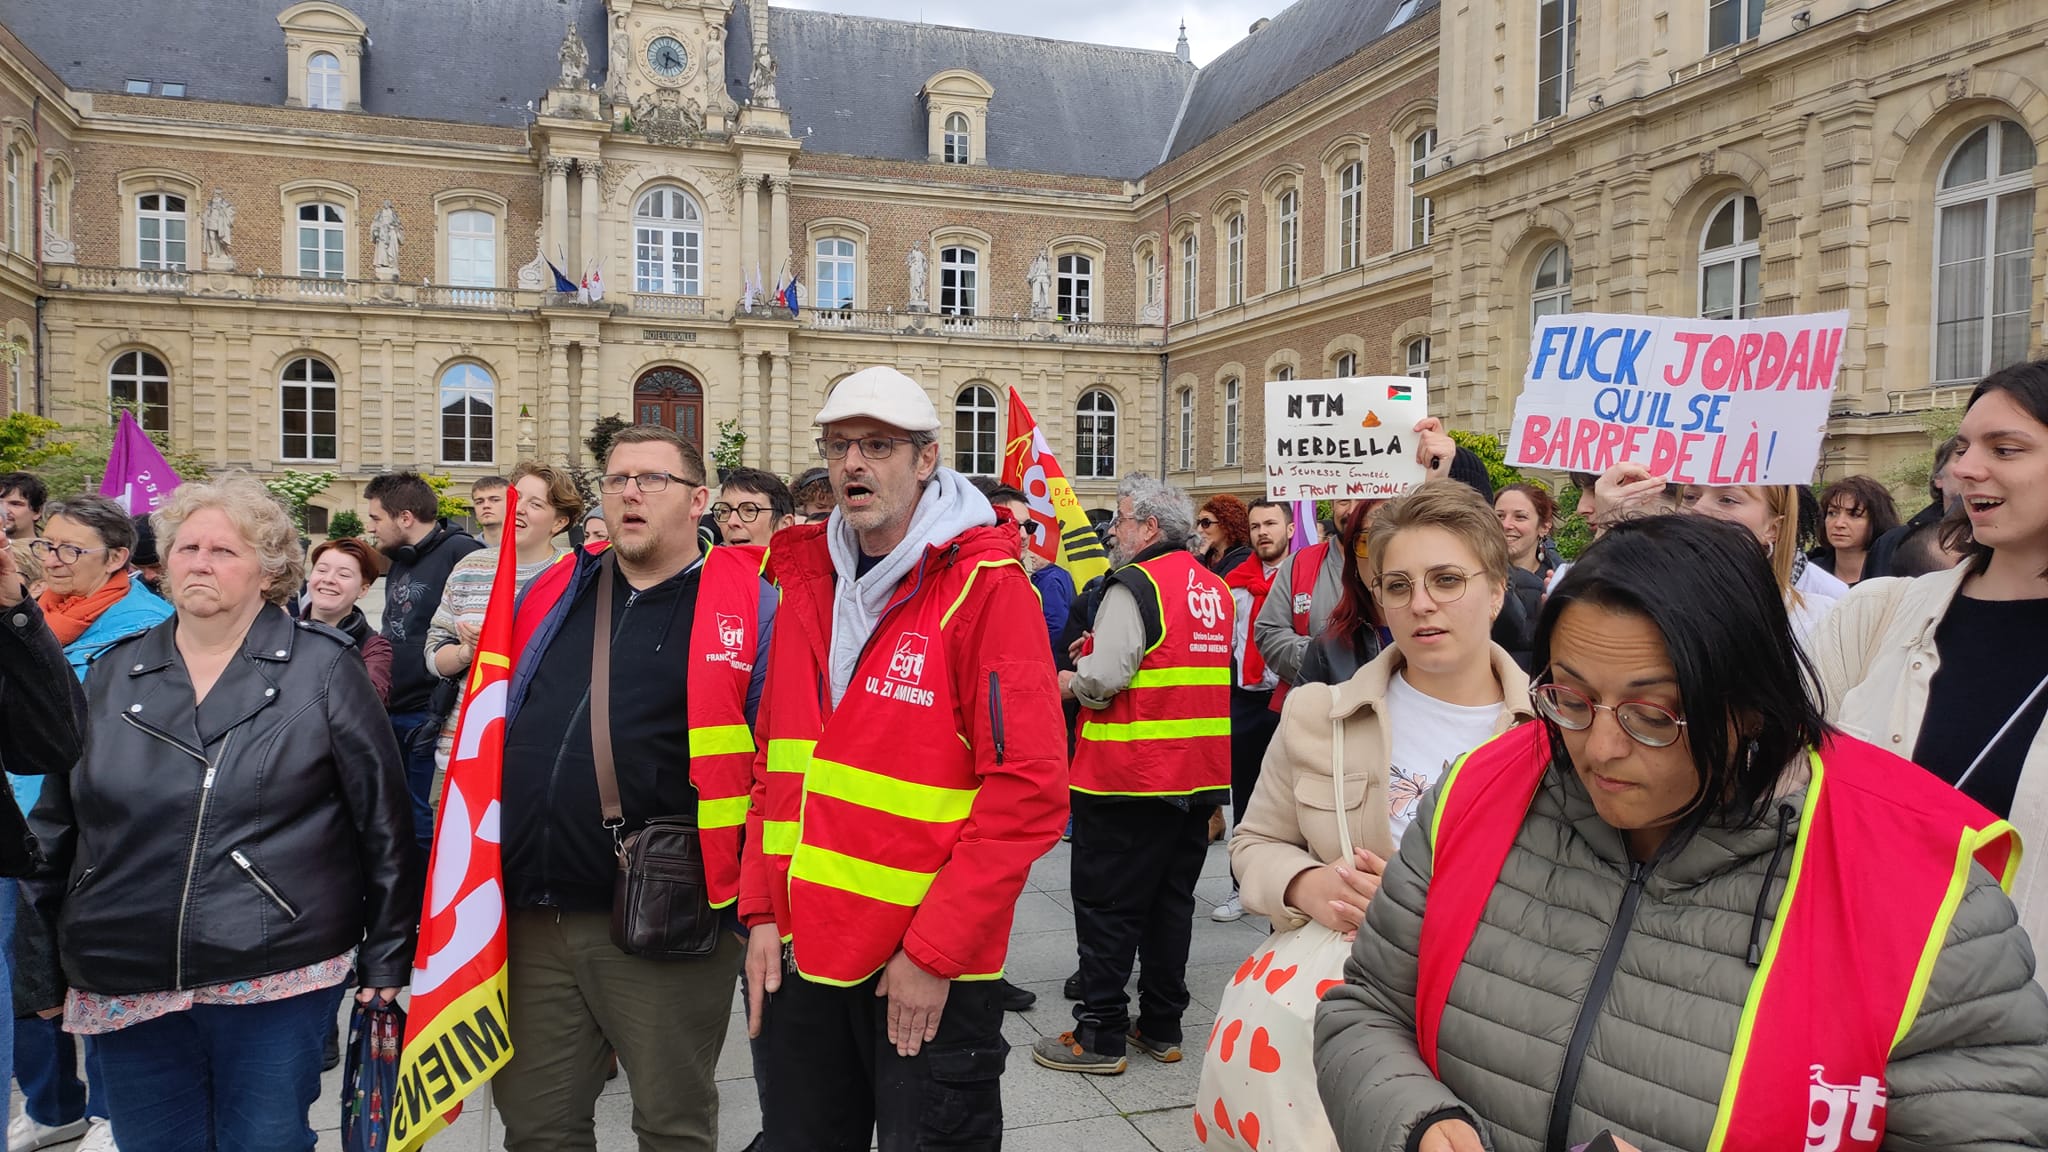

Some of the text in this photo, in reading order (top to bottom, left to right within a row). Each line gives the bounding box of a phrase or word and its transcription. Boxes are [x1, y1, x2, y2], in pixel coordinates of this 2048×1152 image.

[1532, 326, 1843, 392] FUCK JORDAN
[1287, 393, 1344, 418] NTM
[1594, 388, 1731, 433] QU'IL SE
[1277, 434, 1402, 458] MERDELLA
[1518, 415, 1650, 473] BARRE
[1649, 428, 1705, 483] DE
[1268, 465, 1284, 476] LA
[1273, 486, 1287, 496] LE
[1299, 483, 1338, 498] FRONT
[1187, 587, 1225, 629] cgt
[720, 627, 743, 647] gt
[890, 653, 925, 679] cgt
[865, 676, 935, 708] UL ZI AMIENS
[1803, 1075, 1887, 1152] gt
